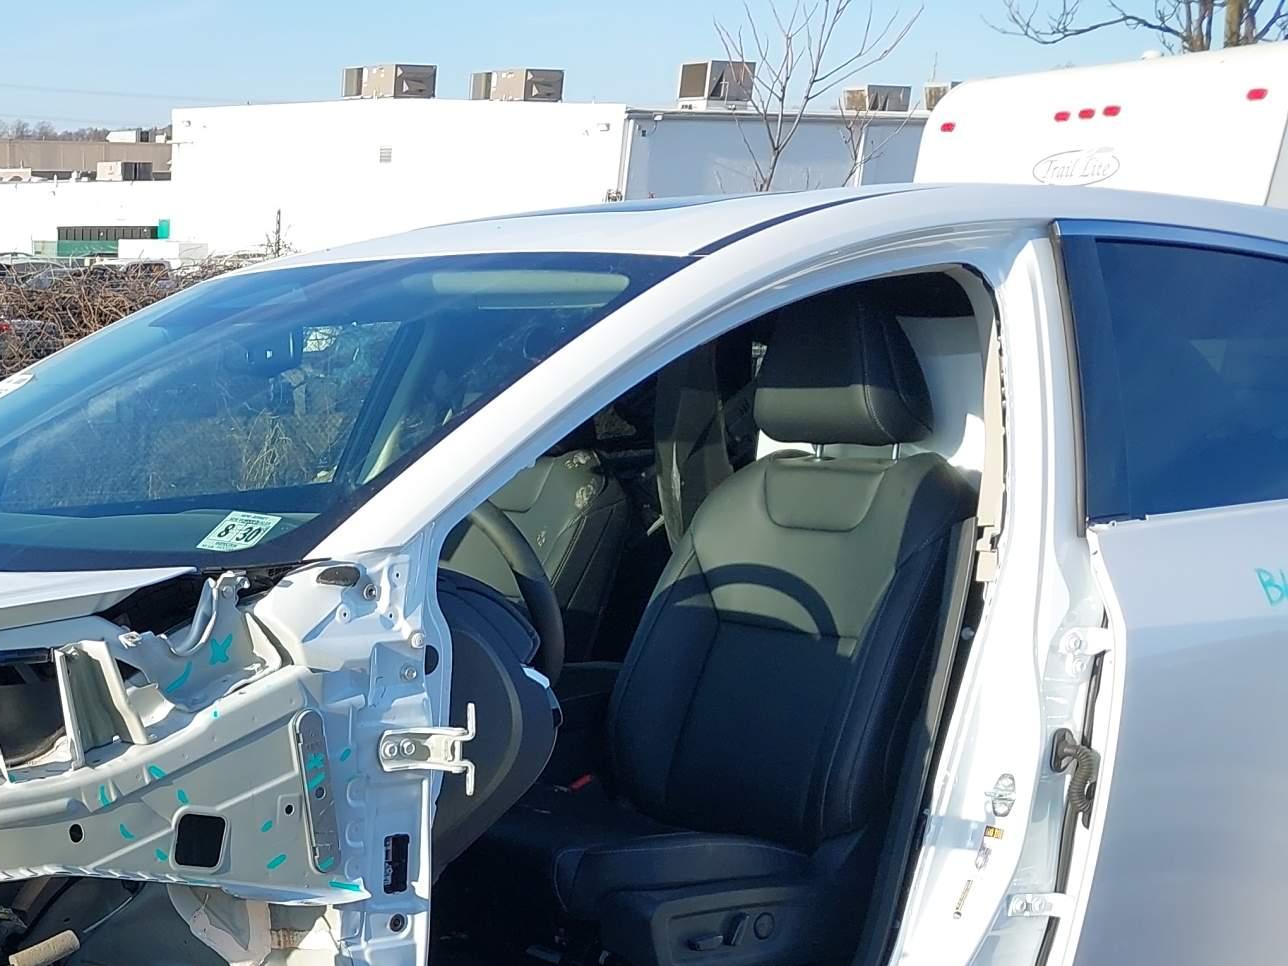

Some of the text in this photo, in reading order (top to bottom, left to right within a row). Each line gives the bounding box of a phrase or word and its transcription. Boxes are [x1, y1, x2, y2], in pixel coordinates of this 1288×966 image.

[1037, 157, 1111, 178] Trail Lite
[217, 523, 262, 543] 8 30
